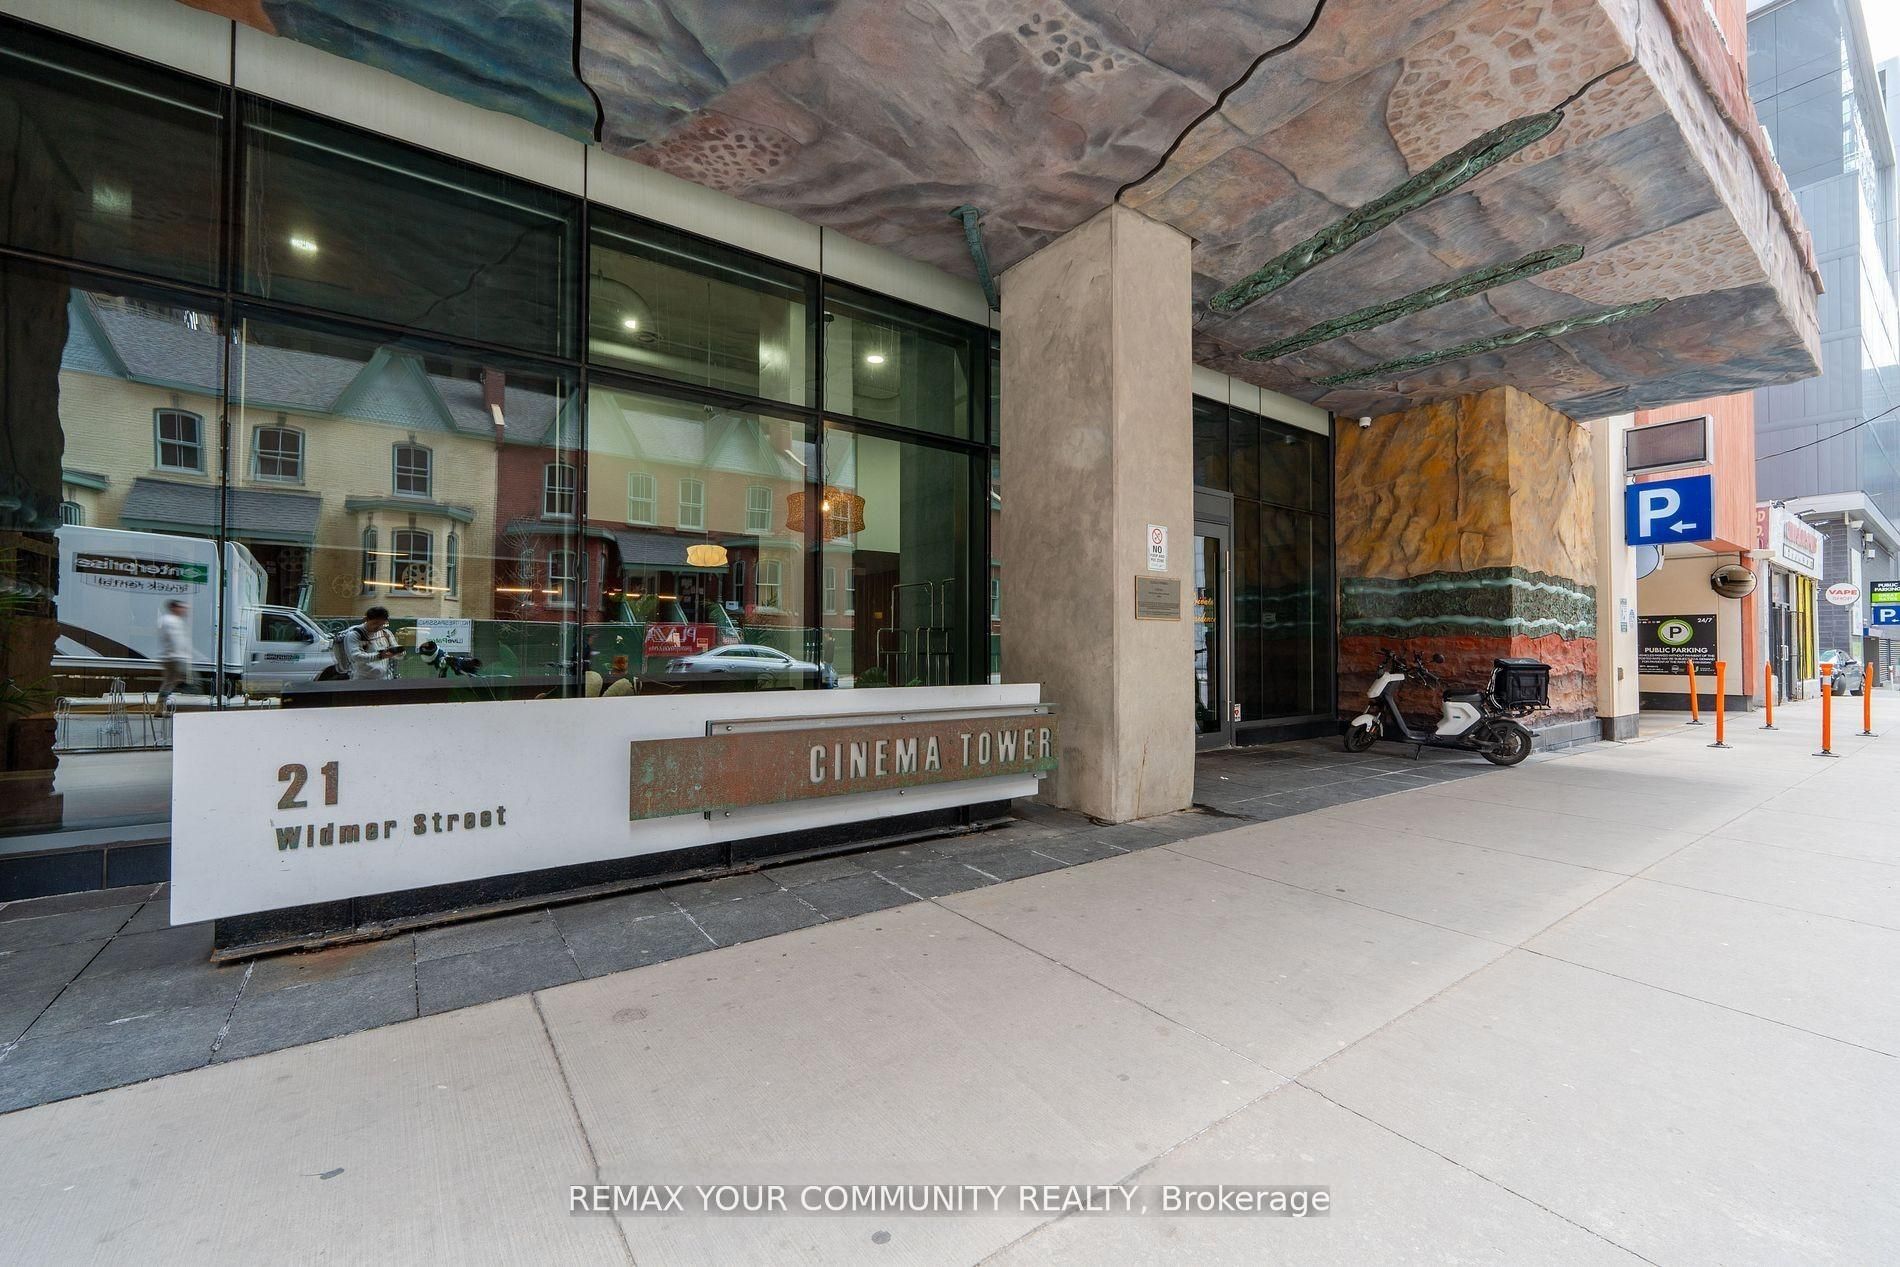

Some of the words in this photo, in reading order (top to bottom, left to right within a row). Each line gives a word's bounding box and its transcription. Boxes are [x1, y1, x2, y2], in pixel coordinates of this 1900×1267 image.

[1639, 488, 1680, 538] P
[1152, 545, 1163, 554] NO
[1669, 626, 1682, 639] P
[1880, 609, 1896, 622] P
[810, 736, 941, 784] CINEMA
[960, 727, 1052, 767] TOWER
[277, 761, 339, 810] 21
[276, 820, 397, 851] Widmer
[413, 805, 507, 835] Street
